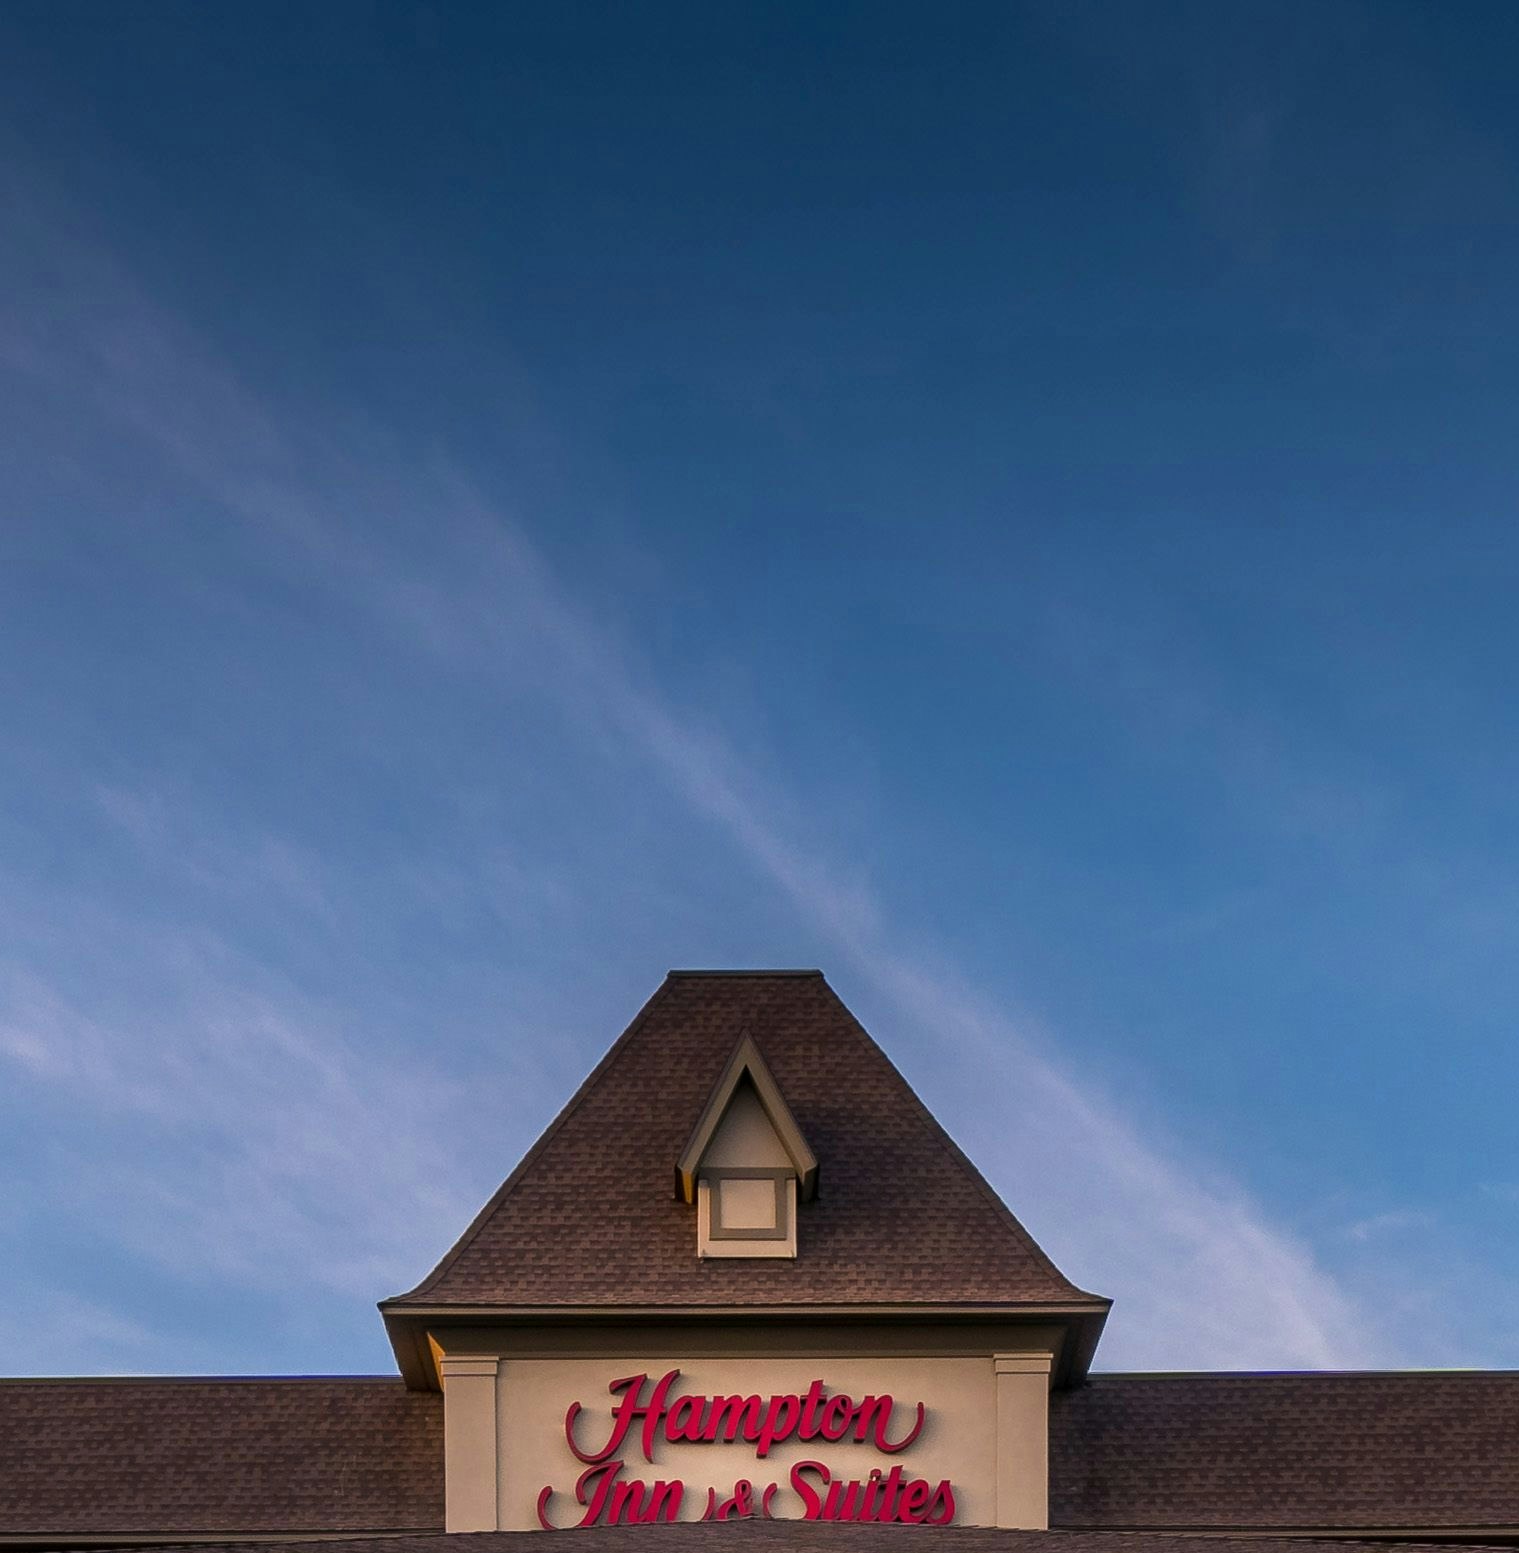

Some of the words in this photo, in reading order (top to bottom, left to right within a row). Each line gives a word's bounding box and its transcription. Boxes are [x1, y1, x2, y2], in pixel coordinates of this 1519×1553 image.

[565, 1368, 926, 1463] Hampton
[537, 1459, 716, 1530] Inn
[762, 1460, 956, 1527] Suites
